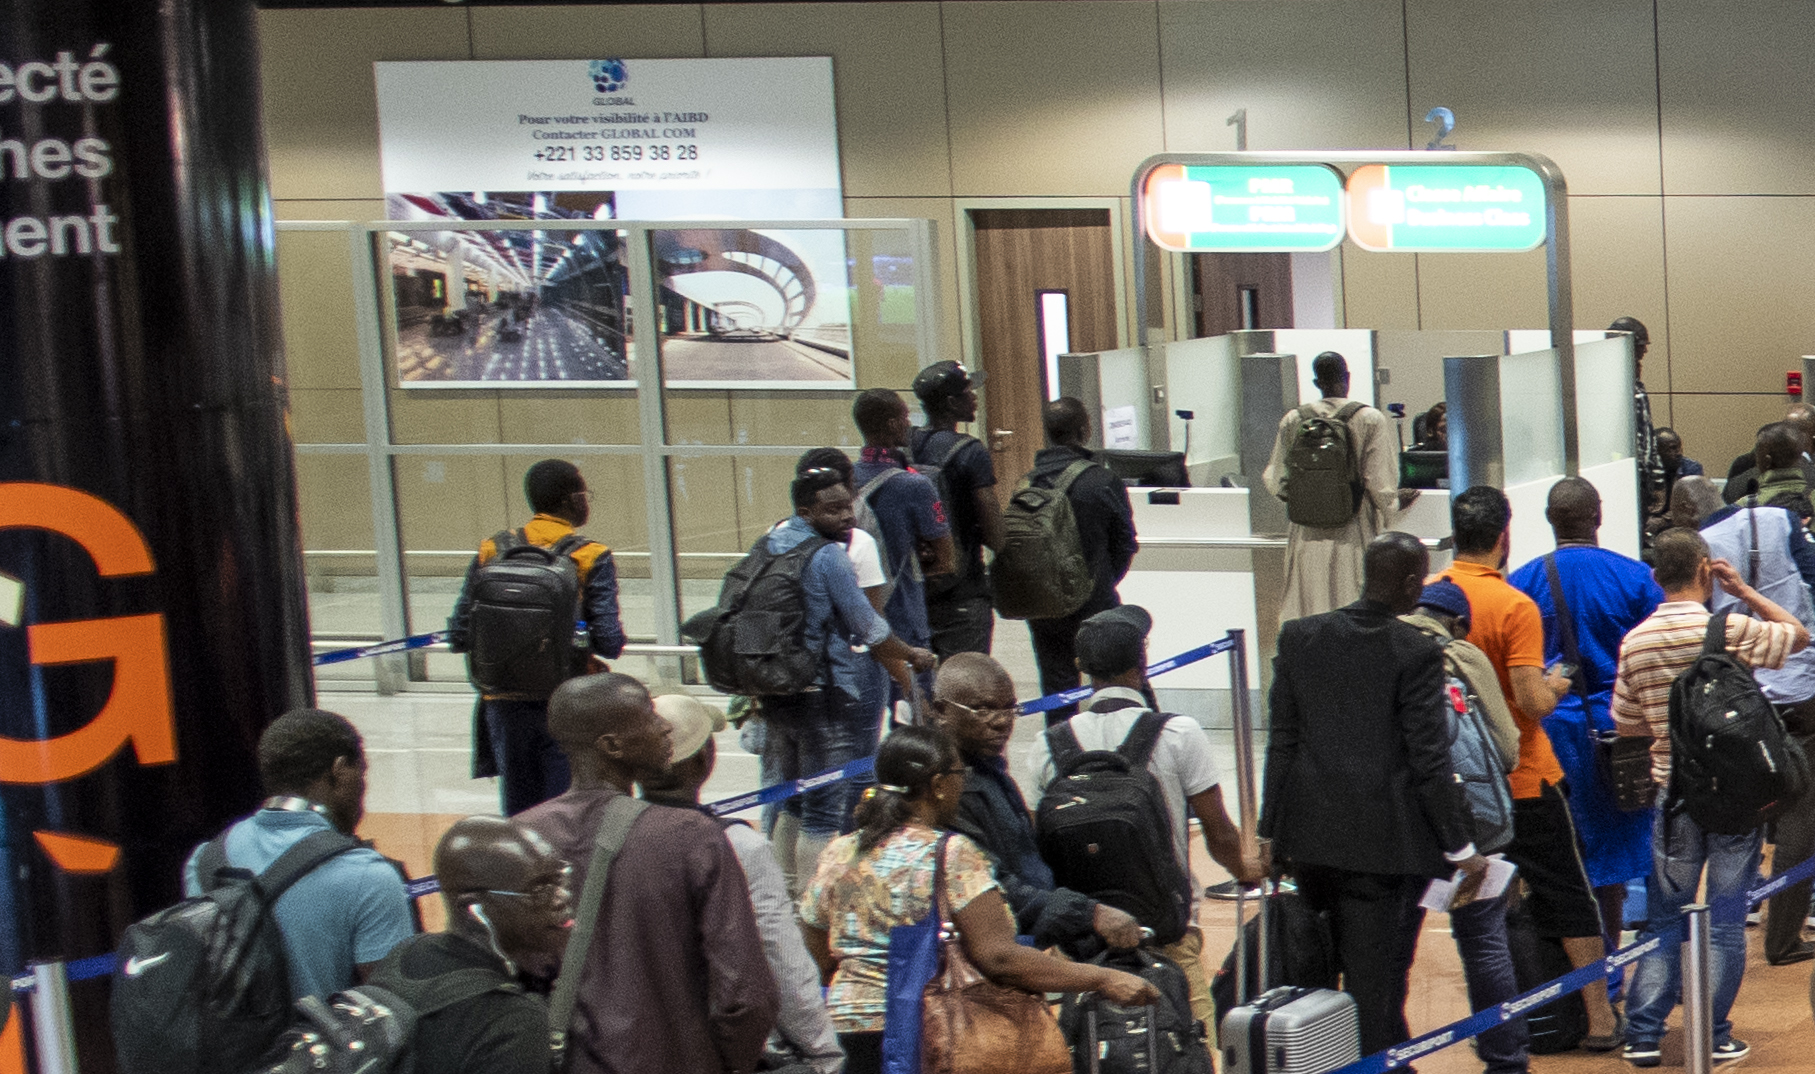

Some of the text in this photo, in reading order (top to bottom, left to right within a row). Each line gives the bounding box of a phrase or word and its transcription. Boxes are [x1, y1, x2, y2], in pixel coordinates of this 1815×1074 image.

[592, 97, 636, 106] GLOBAL
[518, 114, 551, 125] Pour
[553, 116, 590, 124] votre
[592, 113, 650, 124] visibilité
[532, 128, 697, 140] Contacter GLOBAL COM
[1225, 108, 1248, 151] 1
[1424, 107, 1457, 151] 2
[534, 144, 699, 161] +221 33 859 38 28
[0, 204, 121, 256] ent
